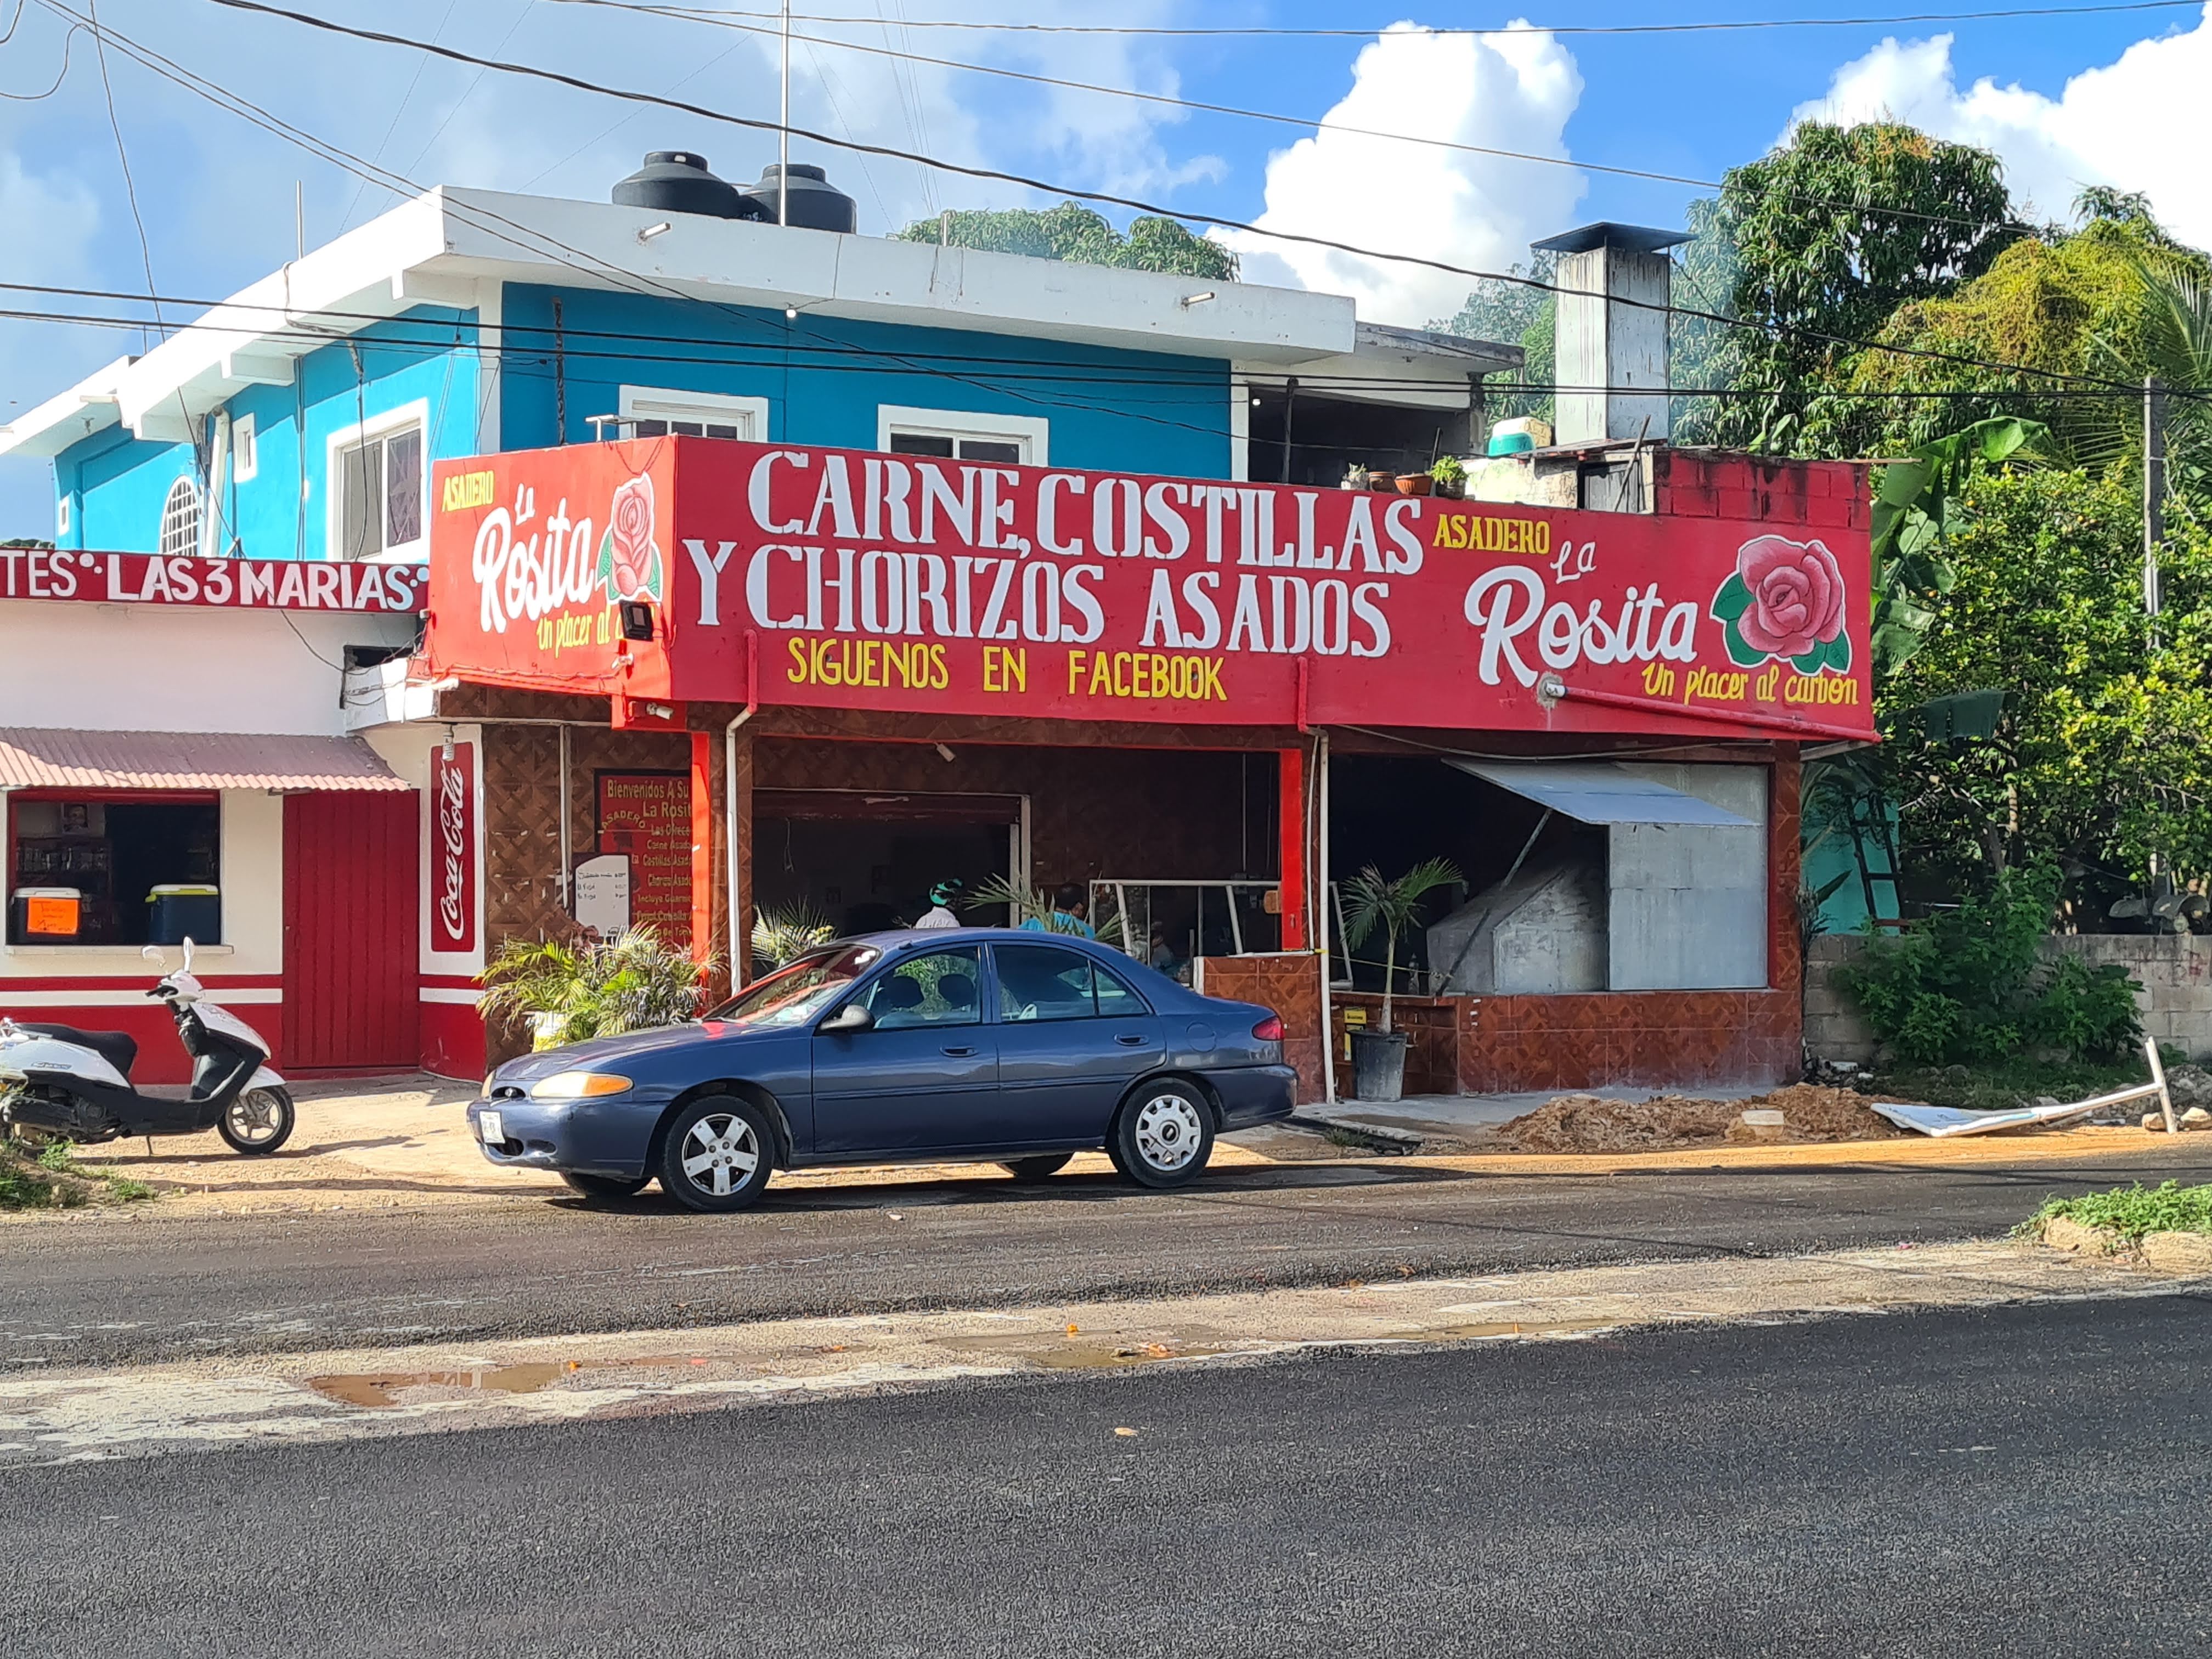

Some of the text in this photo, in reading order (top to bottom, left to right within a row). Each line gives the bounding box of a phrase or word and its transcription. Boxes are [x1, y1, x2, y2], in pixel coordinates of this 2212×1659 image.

[441, 469, 494, 513] ASADERO
[514, 482, 536, 526] La
[1036, 473, 1425, 575] COSTILLAS
[1432, 513, 1550, 555] ASADERO
[107, 554, 199, 602] LAS
[203, 560, 233, 604] 3
[239, 561, 415, 611] MARIAS
[472, 497, 595, 634] Rosita
[1549, 540, 1597, 584] La
[681, 539, 738, 626] Y
[745, 544, 1105, 645] CHORIZOS
[1138, 568, 1392, 659] ASADOS
[555, 610, 592, 659] placer
[596, 602, 611, 645] al
[1463, 565, 1699, 688] Rosita
[787, 636, 1228, 701] SIGUENOS EN FACEBOOK
[1641, 662, 1859, 707] Un placer al carbón
[607, 779, 689, 799] Bienvenidos A Su
[642, 800, 657, 817] La
[601, 810, 646, 831] ASADERO
